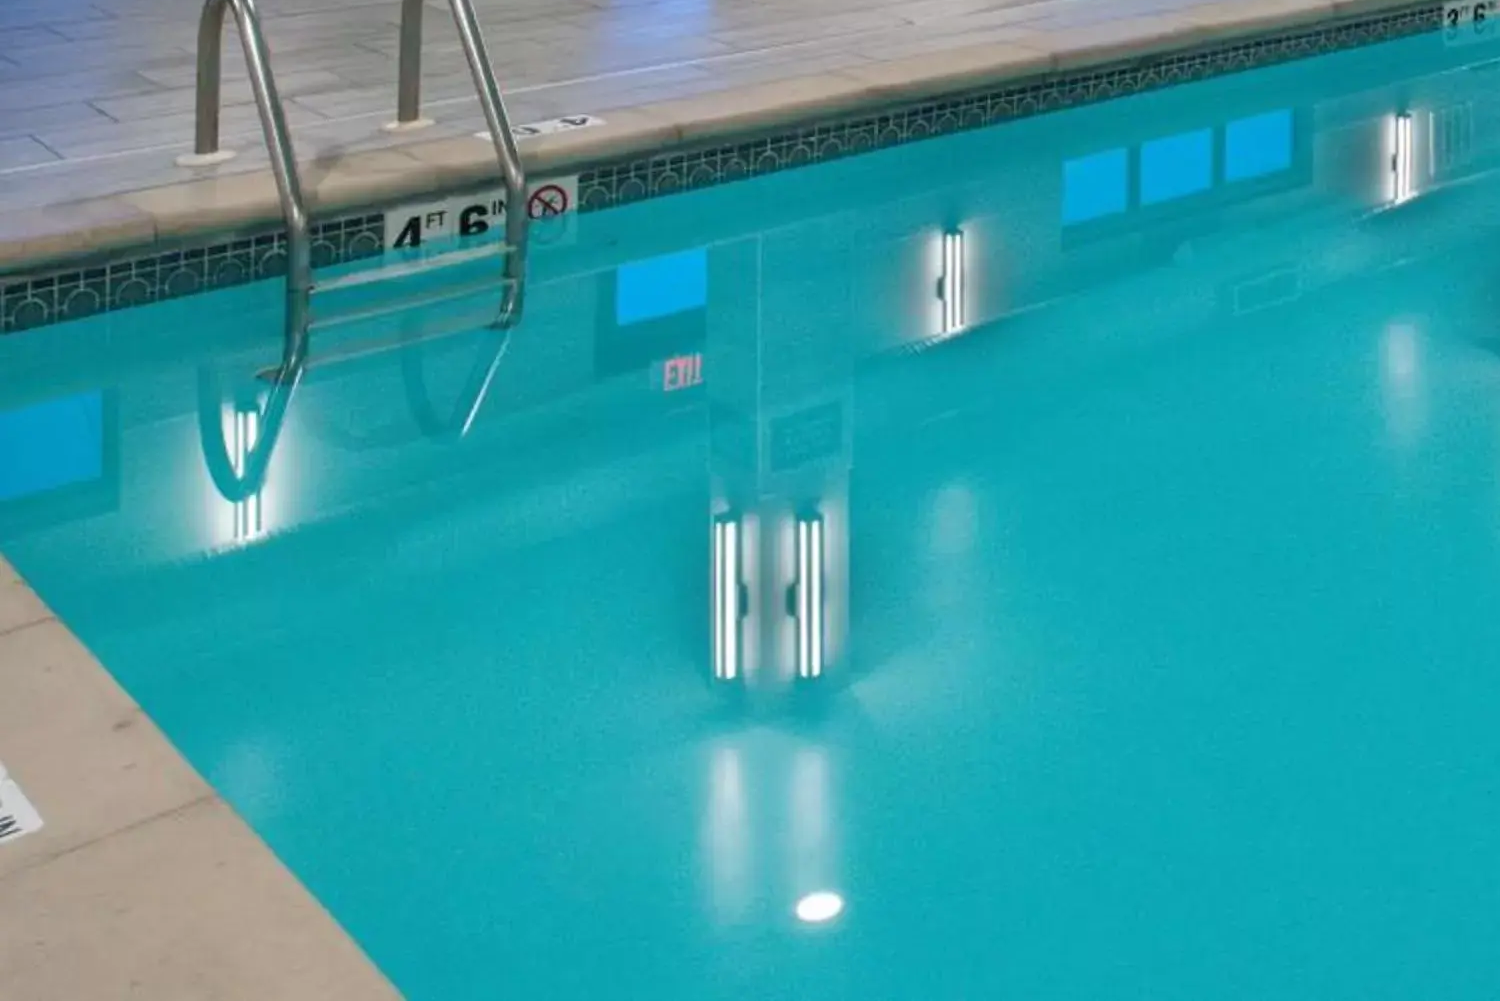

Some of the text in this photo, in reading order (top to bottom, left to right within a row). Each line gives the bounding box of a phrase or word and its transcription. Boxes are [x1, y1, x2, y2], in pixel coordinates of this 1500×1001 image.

[393, 215, 422, 248] 4
[425, 210, 447, 230] FT
[459, 204, 490, 237] 6
